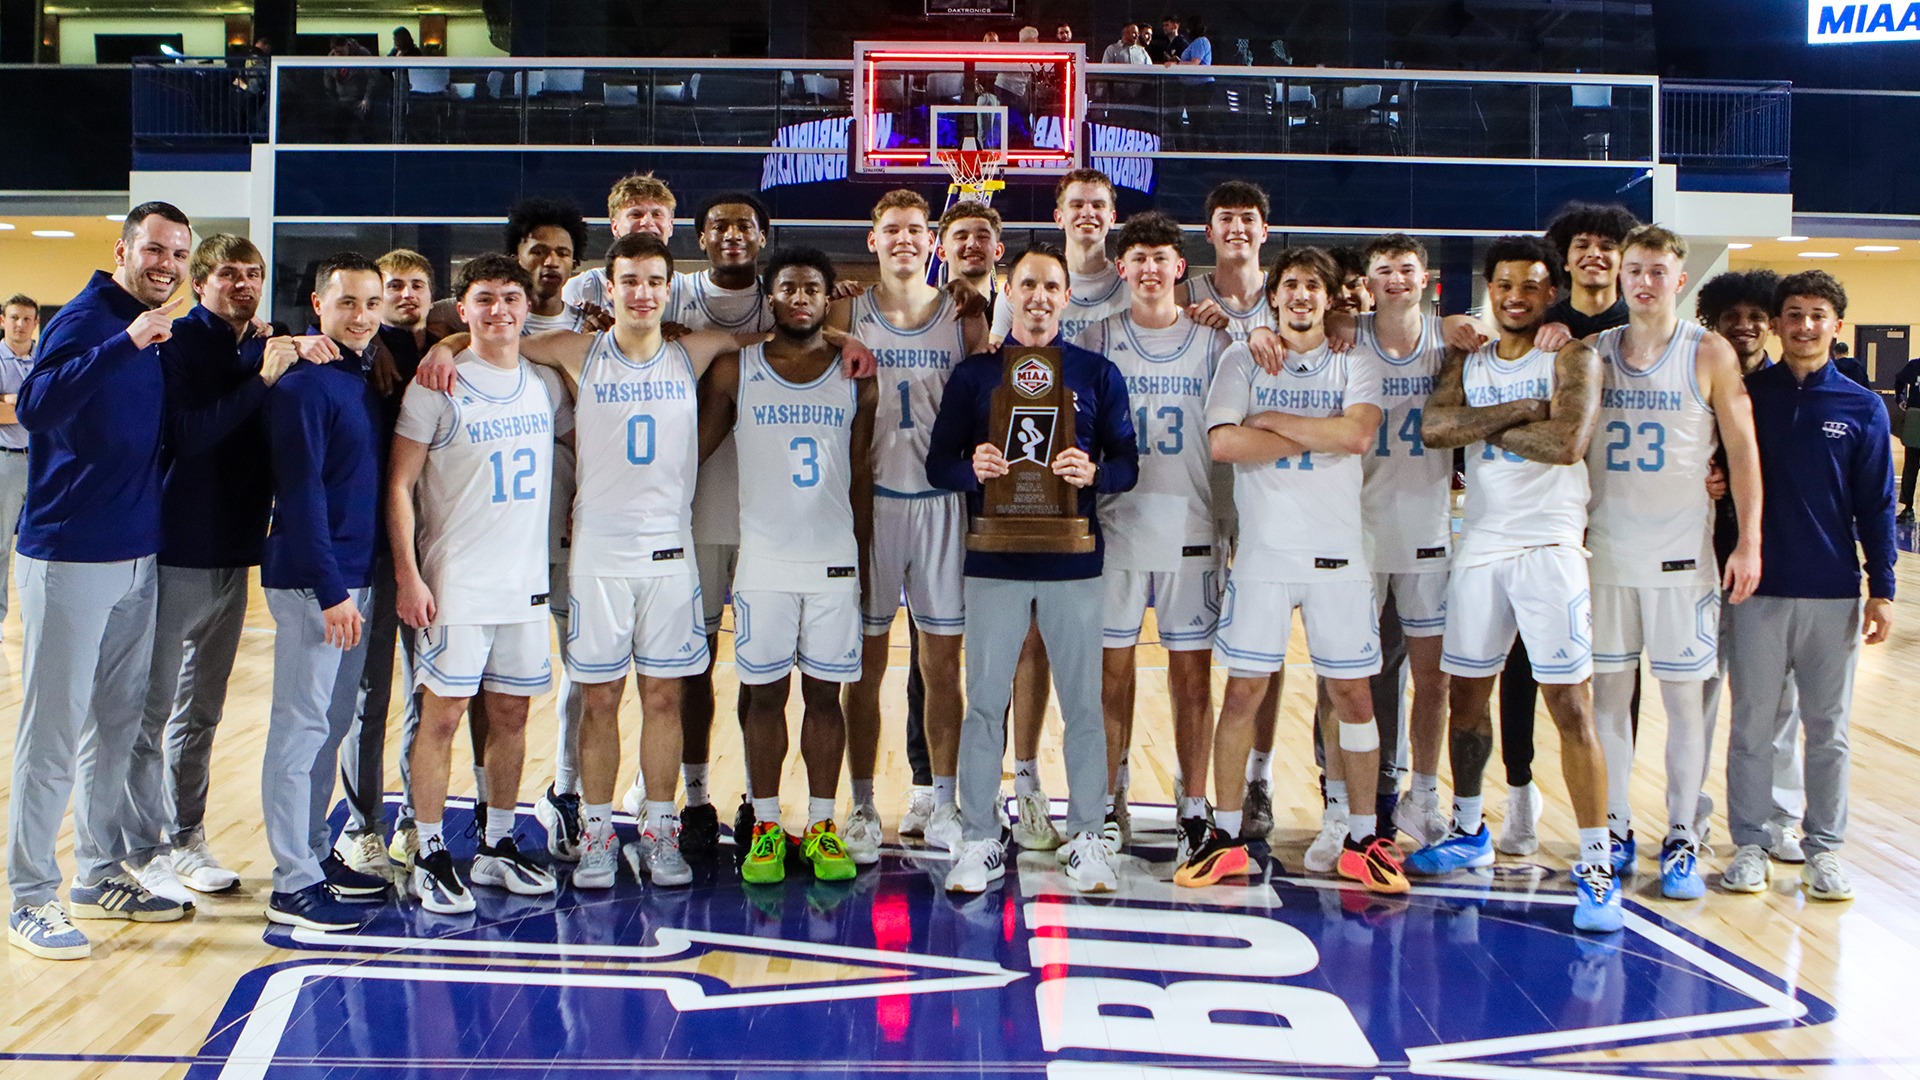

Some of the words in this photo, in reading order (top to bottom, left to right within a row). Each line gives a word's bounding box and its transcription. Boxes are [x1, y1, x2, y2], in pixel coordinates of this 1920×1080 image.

[1817, 2, 1920, 34] MIAA
[869, 348, 951, 370] ASHBURN
[1017, 371, 1049, 381] MIAA
[1122, 375, 1203, 397] ASHBURN
[1381, 375, 1440, 396] SHBUR
[592, 380, 687, 403] WASHBURN
[896, 380, 914, 429] 1
[1255, 386, 1344, 410] WASHBURN
[1467, 378, 1548, 405] WASHBURN
[1601, 387, 1682, 411] ASHBURN
[465, 412, 550, 444] WASHBURN
[752, 404, 845, 428] WASHBURN
[1135, 406, 1184, 455] 13
[626, 414, 656, 466] 0
[1375, 407, 1425, 457] 14
[1605, 420, 1666, 472] 23
[489, 447, 537, 503] 12
[789, 436, 820, 488] 3
